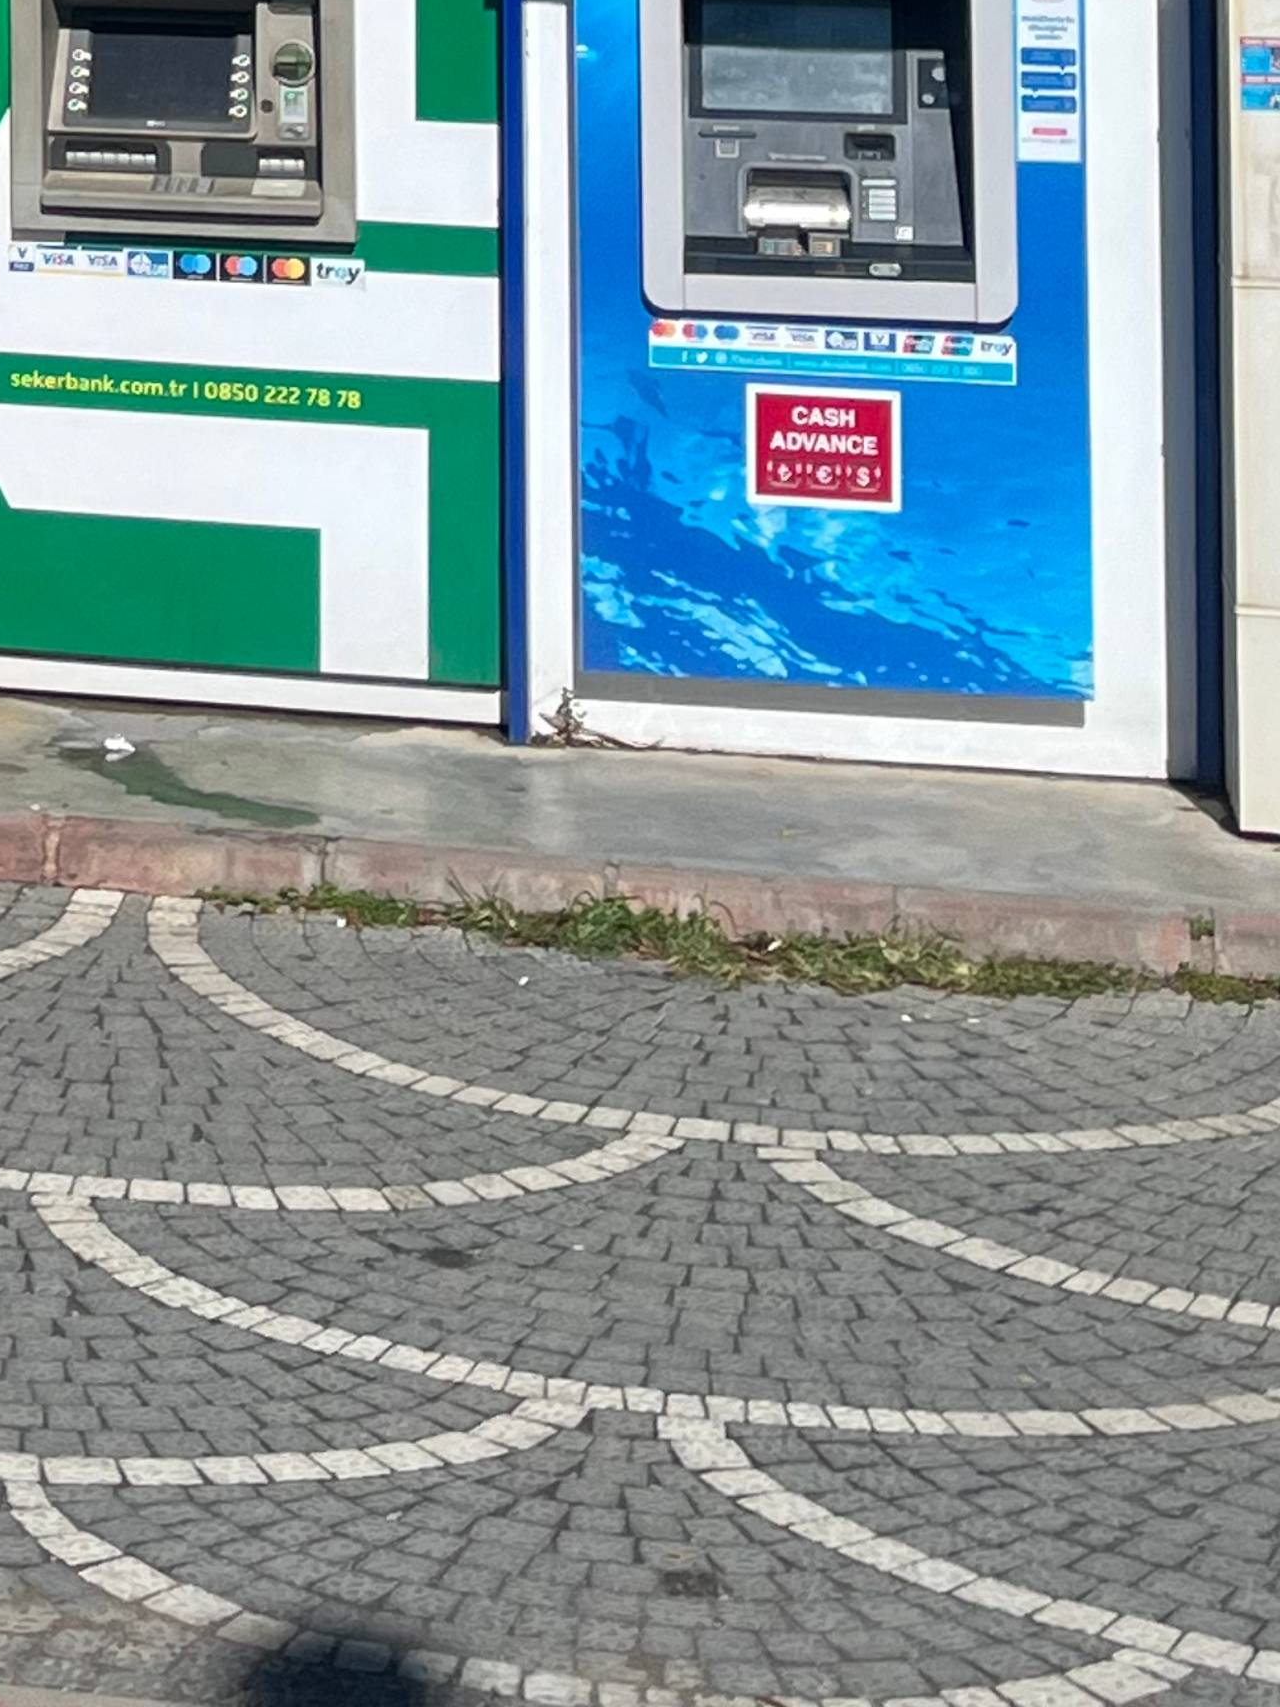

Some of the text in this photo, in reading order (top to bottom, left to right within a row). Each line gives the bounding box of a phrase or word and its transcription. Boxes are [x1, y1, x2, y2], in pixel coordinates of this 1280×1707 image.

[43, 252, 75, 266] VISA
[87, 254, 118, 267] VISA
[316, 262, 362, 285] troy
[981, 340, 1013, 356] troy
[10, 369, 361, 409] sekerbank.com.tr 0850 222 78 78
[791, 405, 856, 427] CASH
[770, 431, 879, 456] ADVANCE
